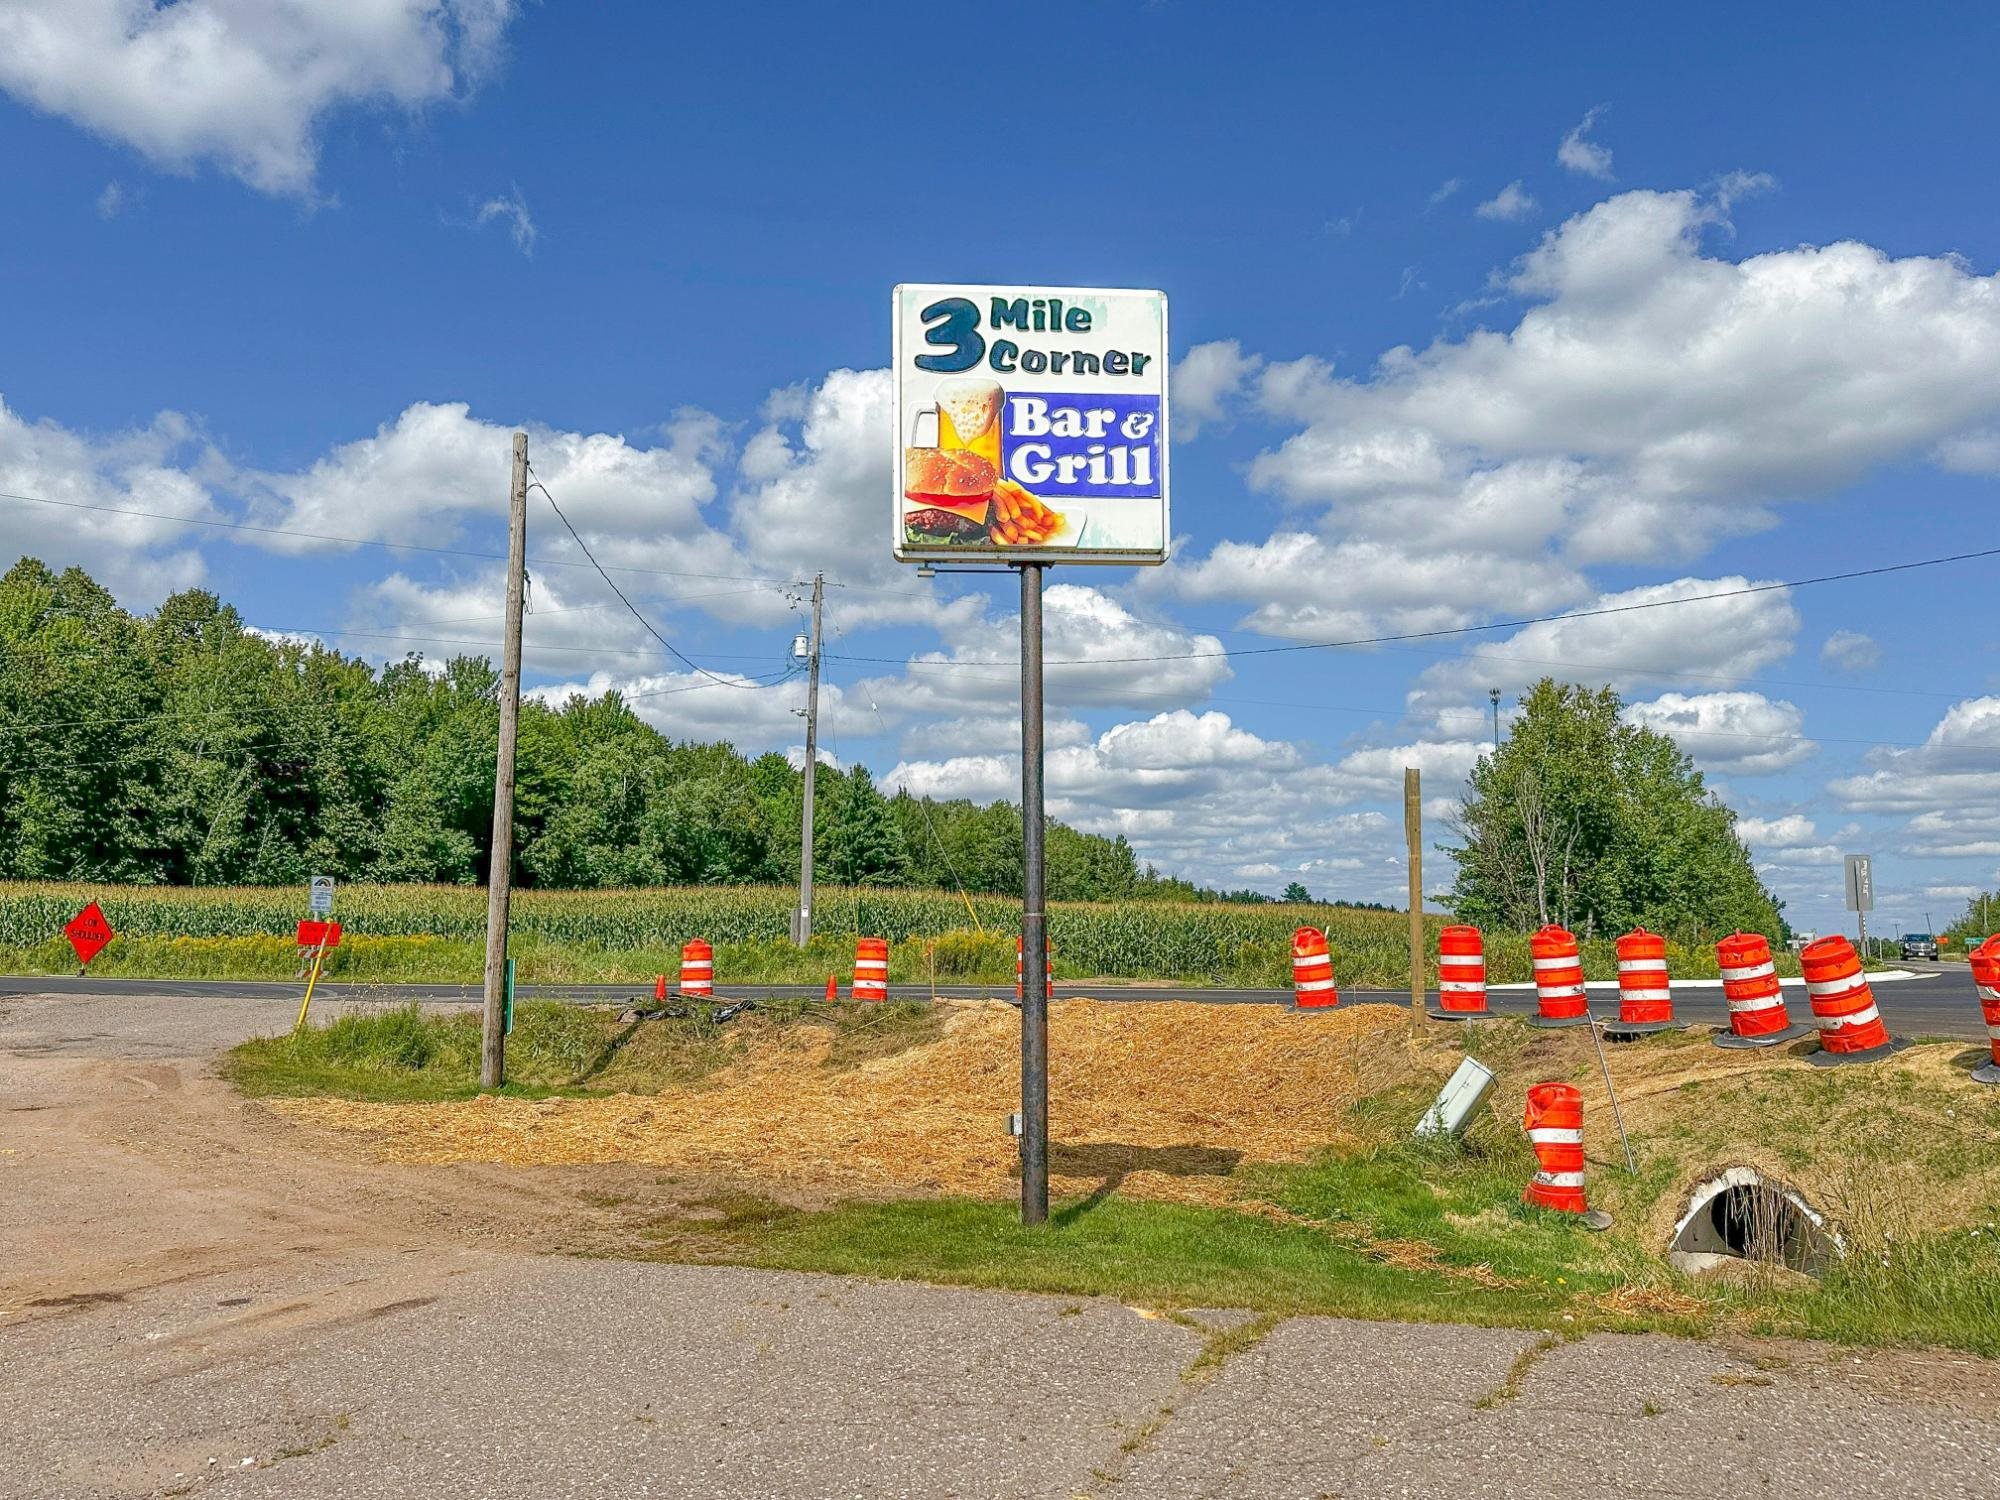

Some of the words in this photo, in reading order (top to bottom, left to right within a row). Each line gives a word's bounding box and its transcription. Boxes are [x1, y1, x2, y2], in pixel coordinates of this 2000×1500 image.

[914, 297, 986, 373] 3
[990, 297, 1092, 333] Mile
[989, 339, 1152, 376] Corner
[1009, 396, 1116, 439] Bar
[1121, 411, 1154, 440] &
[1010, 444, 1154, 485] Grill
